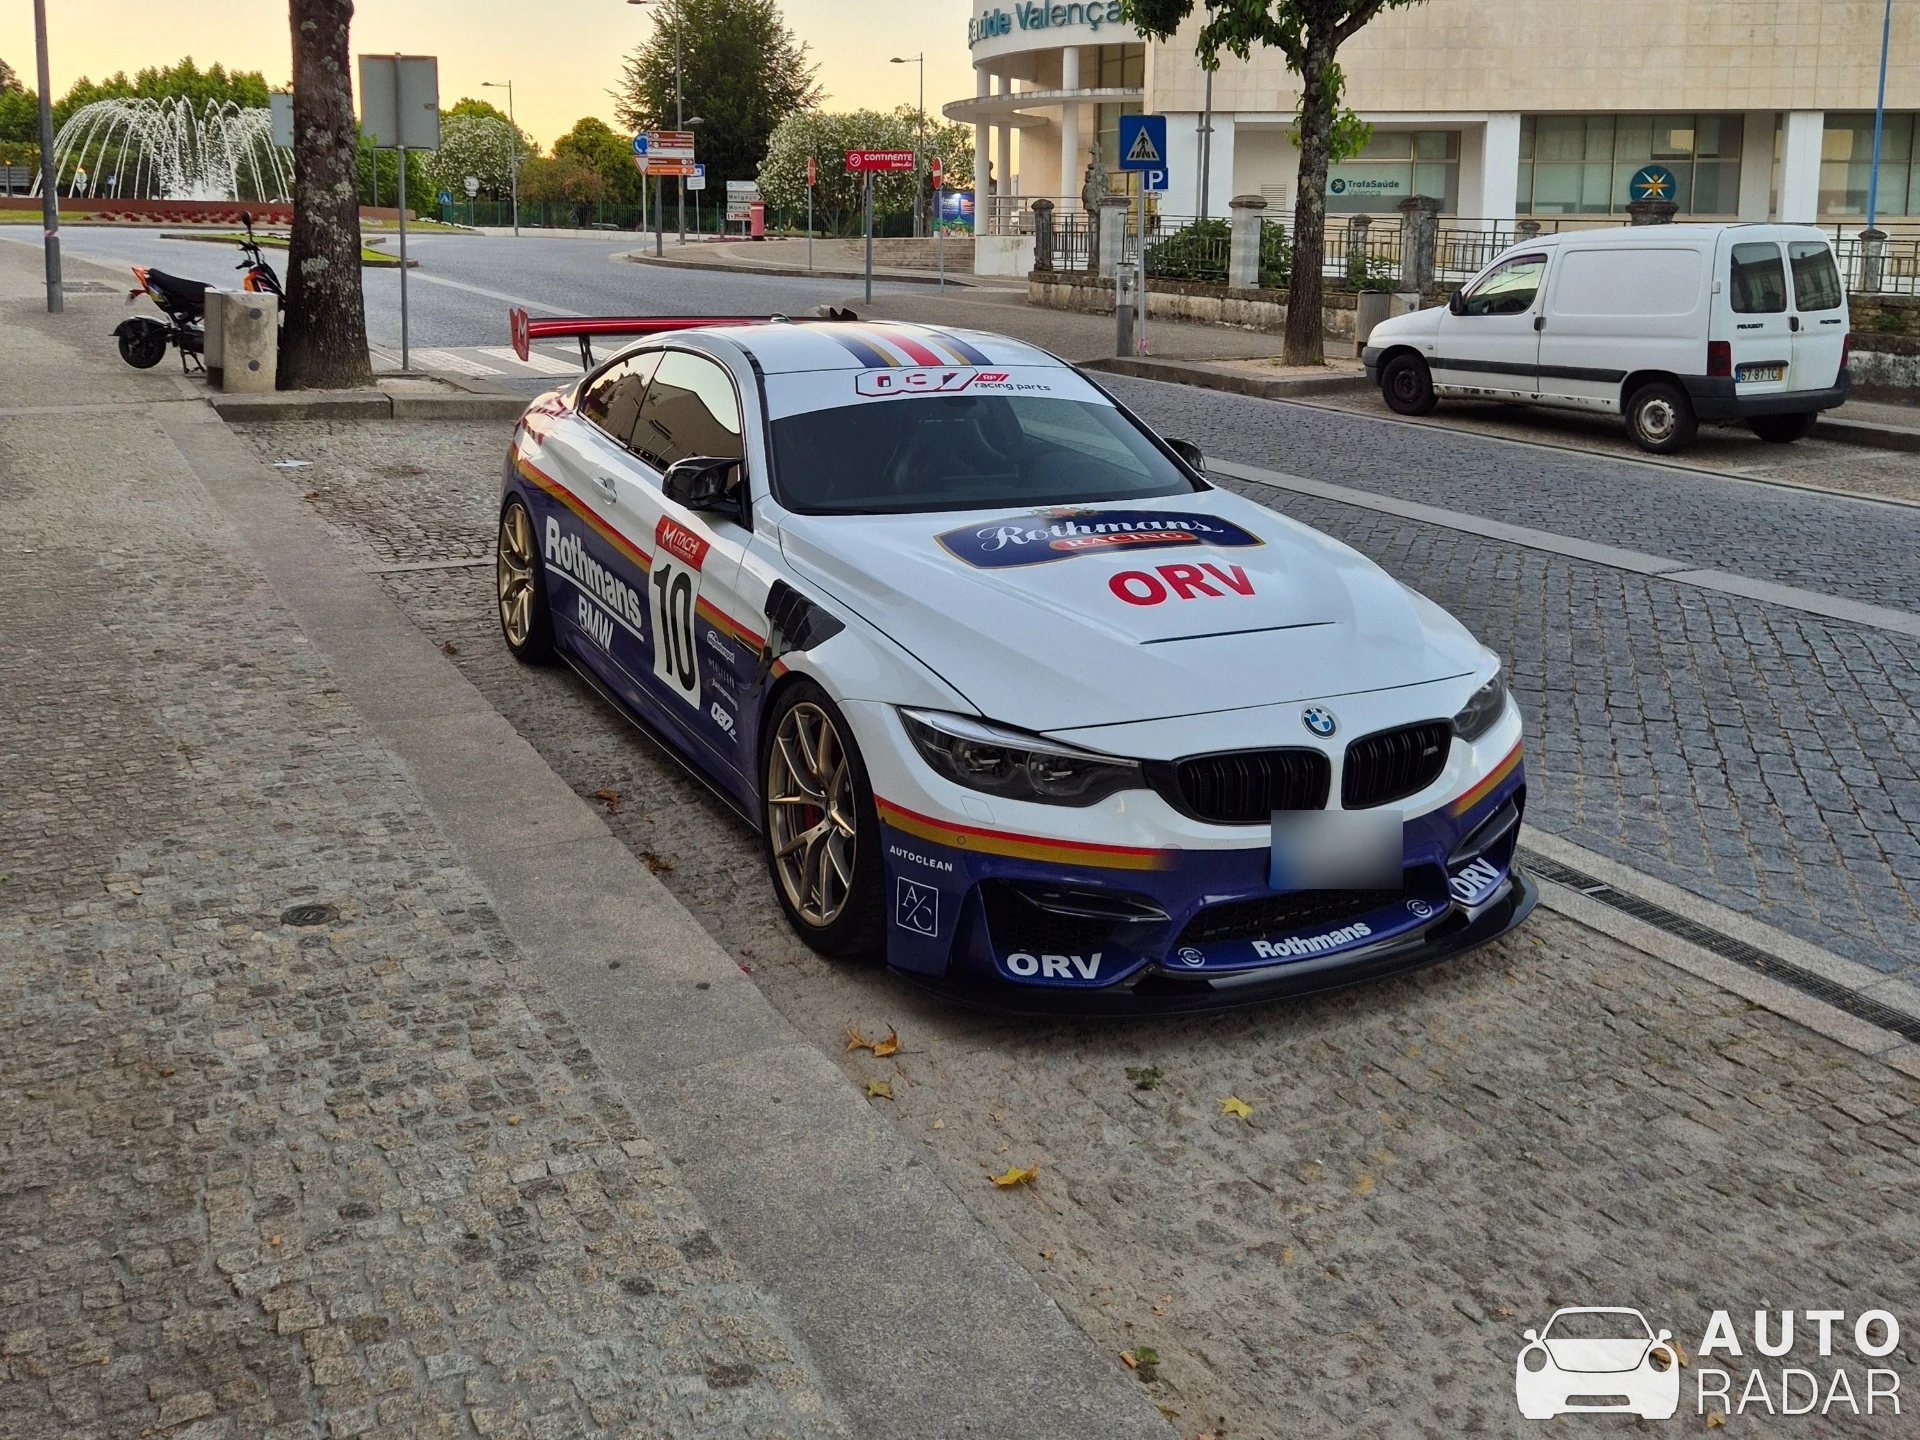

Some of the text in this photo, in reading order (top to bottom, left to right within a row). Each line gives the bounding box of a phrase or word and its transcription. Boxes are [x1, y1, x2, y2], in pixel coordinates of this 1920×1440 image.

[1015, 0, 1122, 31] Valença
[864, 153, 913, 161] CONTINENTE
[1149, 170, 1164, 190] P
[1347, 189, 1381, 198] Valença
[1348, 179, 1400, 188] TrofaSaúde
[855, 367, 979, 397] 037
[974, 382, 1051, 391] racing parts
[976, 519, 1224, 552] Rothmans
[1065, 532, 1181, 547] RACING
[545, 515, 643, 630] Rothmans
[1108, 562, 1256, 606] ORV
[578, 594, 614, 654] BMW
[653, 563, 696, 692] 10
[889, 845, 953, 872] AUTOCLEAN
[1450, 856, 1501, 898] ORV
[1251, 921, 1372, 958] Rothmans
[1006, 952, 1102, 980] ORV
